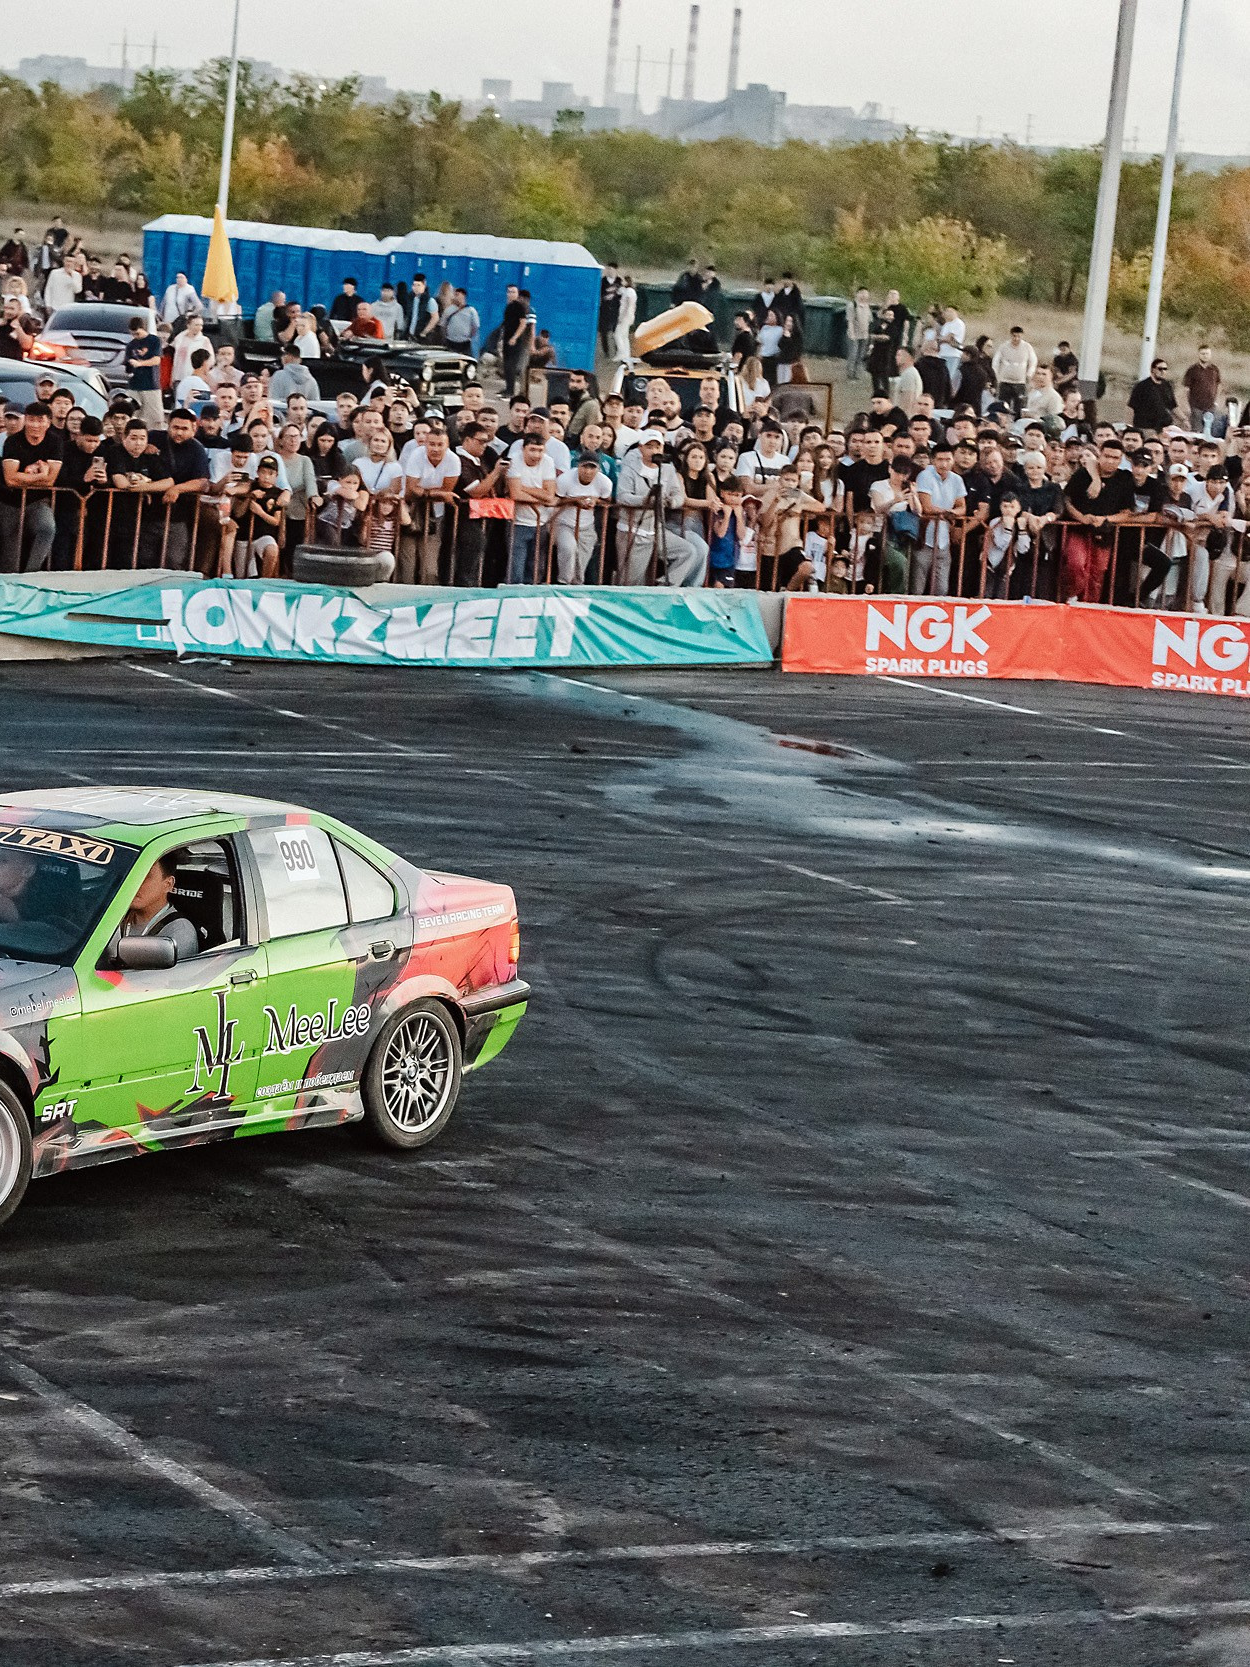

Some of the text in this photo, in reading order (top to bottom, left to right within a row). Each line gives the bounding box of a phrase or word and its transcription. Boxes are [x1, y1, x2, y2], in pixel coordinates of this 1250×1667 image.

[865, 603, 993, 656] NGK
[1151, 618, 1250, 673] NG
[865, 657, 989, 676] SPARK PLUGS
[1151, 671, 1217, 692] SPARK
[17, 830, 108, 861] TAXI
[279, 839, 316, 872] 990
[417, 903, 506, 929] SEVEN RACING TEAM
[263, 998, 371, 1056] MeeLee
[40, 1099, 79, 1123] SRT
